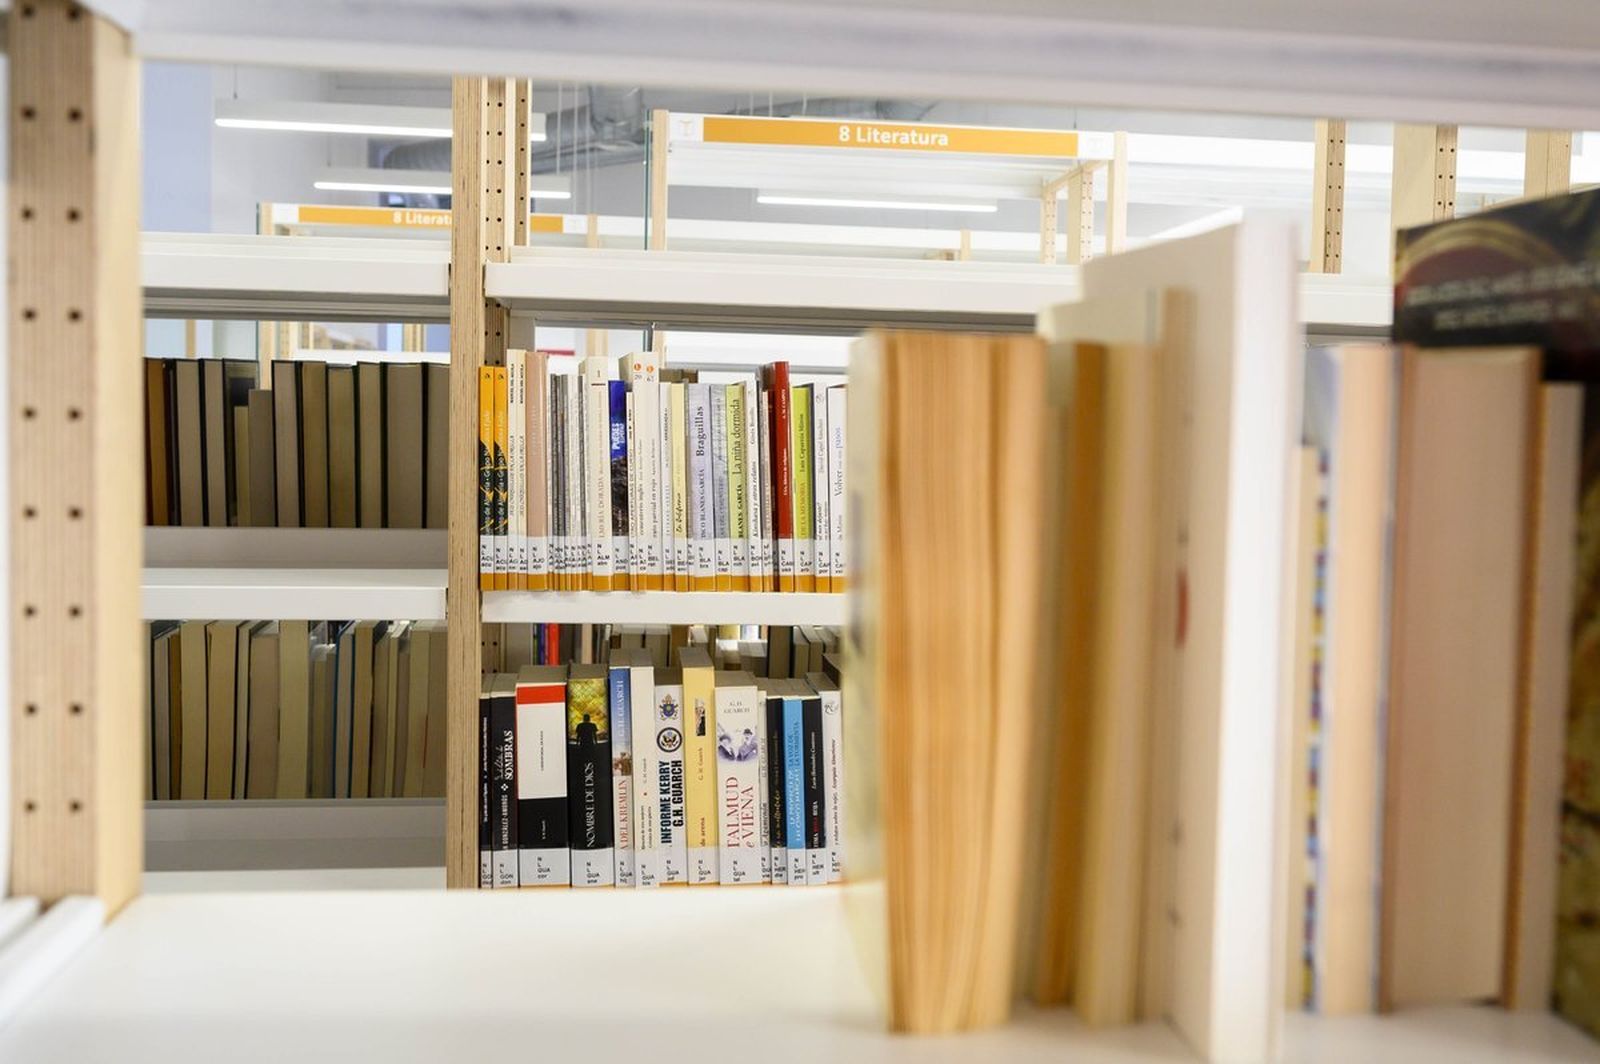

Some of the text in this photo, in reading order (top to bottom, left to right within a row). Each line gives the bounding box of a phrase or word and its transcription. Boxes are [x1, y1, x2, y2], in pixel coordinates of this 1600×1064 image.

[839, 126, 949, 146] 8 Literatura
[393, 211, 402, 225] 8
[694, 406, 708, 457] Braguillas
[729, 399, 741, 439] dormida
[730, 440, 742, 462] niña
[732, 464, 742, 474] La
[834, 470, 844, 496] Volver
[616, 680, 624, 717] GUARCH
[503, 730, 514, 781] SOMBRAS
[583, 762, 596, 848] NOMBRE DE DIOS
[618, 780, 628, 823] KREMLIN
[658, 760, 672, 844] INFORME KERRY
[670, 760, 684, 828] G.H. GUARCH
[740, 786, 755, 840] VIENA
[619, 826, 628, 842] DEL
[700, 838, 706, 847] de
